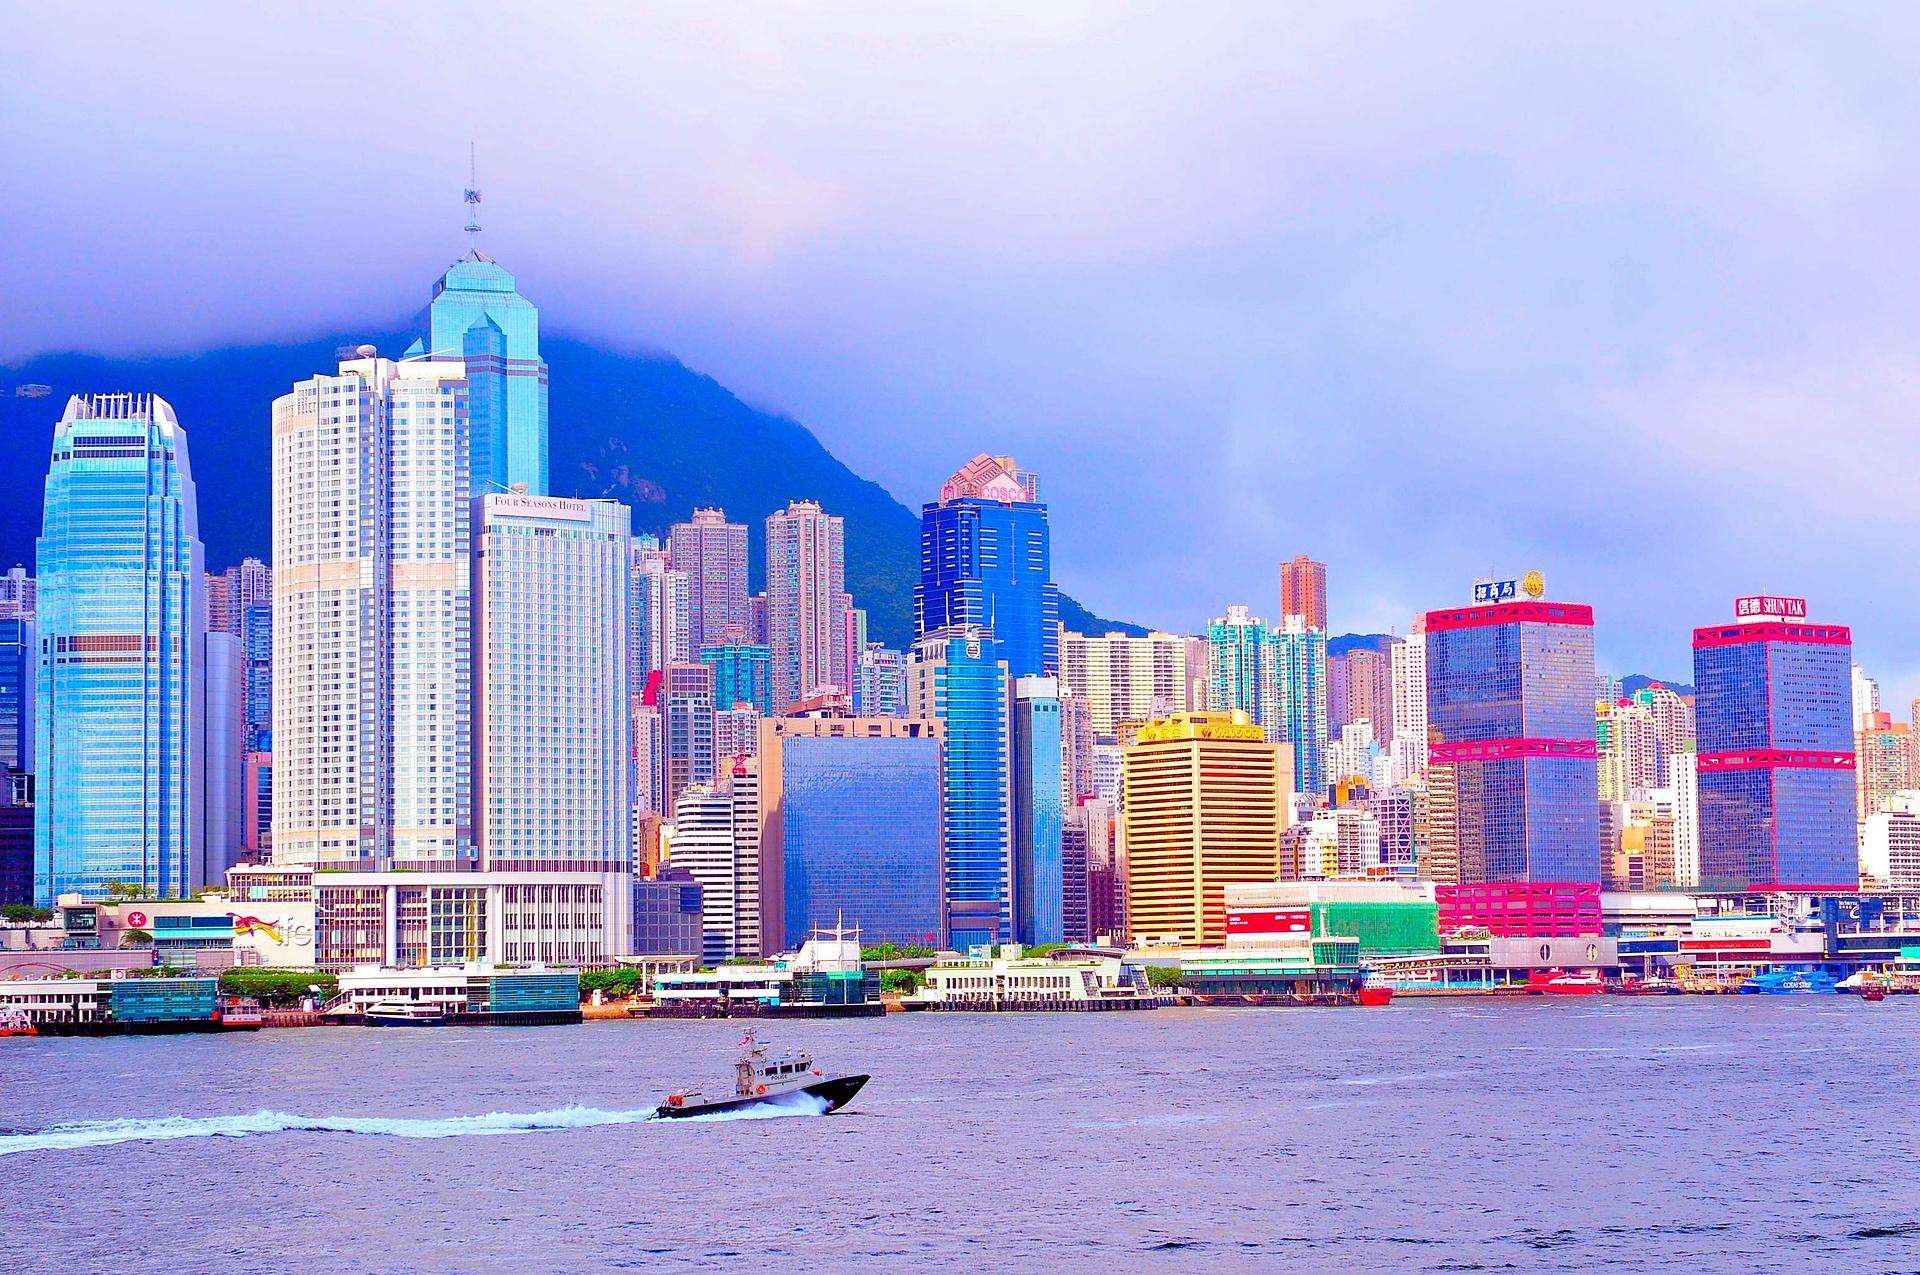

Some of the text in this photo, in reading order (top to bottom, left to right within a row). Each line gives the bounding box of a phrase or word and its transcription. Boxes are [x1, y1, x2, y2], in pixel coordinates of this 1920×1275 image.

[559, 500, 586, 512] HOTEL
[1738, 598, 1761, 616] 信德
[1763, 597, 1804, 616] SHUN TAK
[756, 1069, 764, 1077] 13
